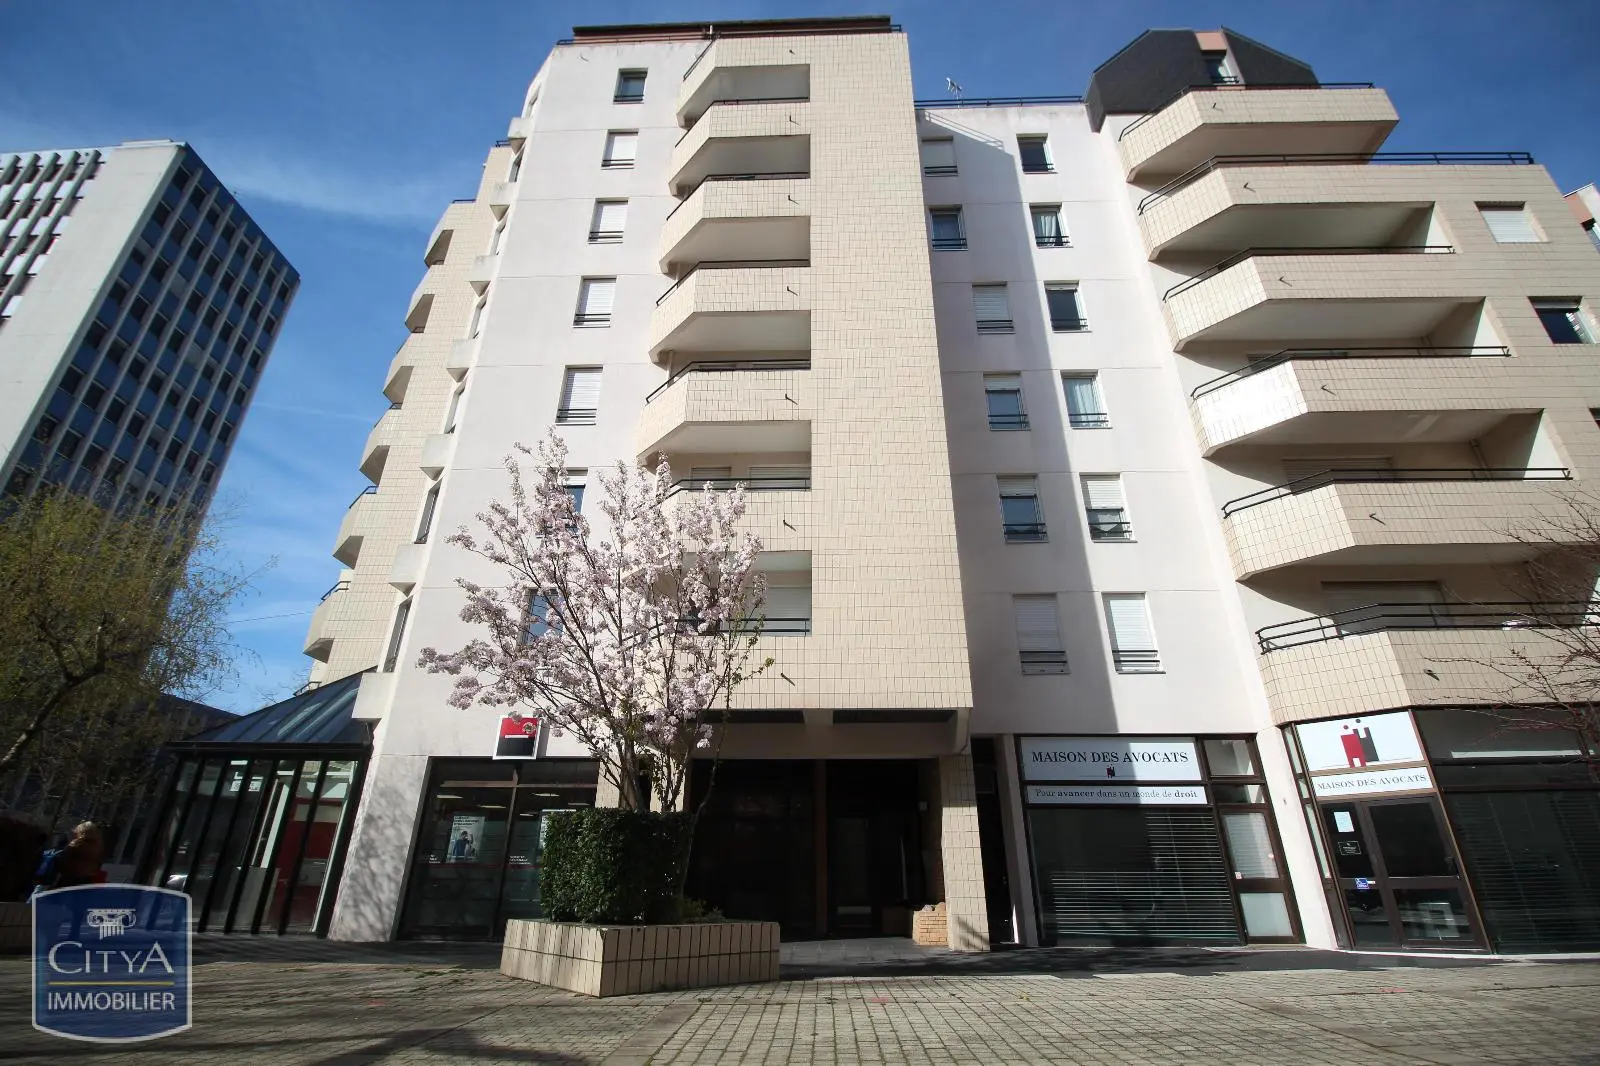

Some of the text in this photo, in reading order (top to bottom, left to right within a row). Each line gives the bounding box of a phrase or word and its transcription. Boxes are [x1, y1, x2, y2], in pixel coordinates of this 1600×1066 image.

[1032, 751, 1189, 763] MAISON DES AVOCATS
[1317, 774, 1427, 790] MAISON DES AVOCATS
[1036, 789, 1056, 797] Pour
[1097, 789, 1117, 798] dans
[1133, 789, 1160, 798] monde
[1162, 789, 1172, 798] de
[1174, 789, 1198, 798] droit
